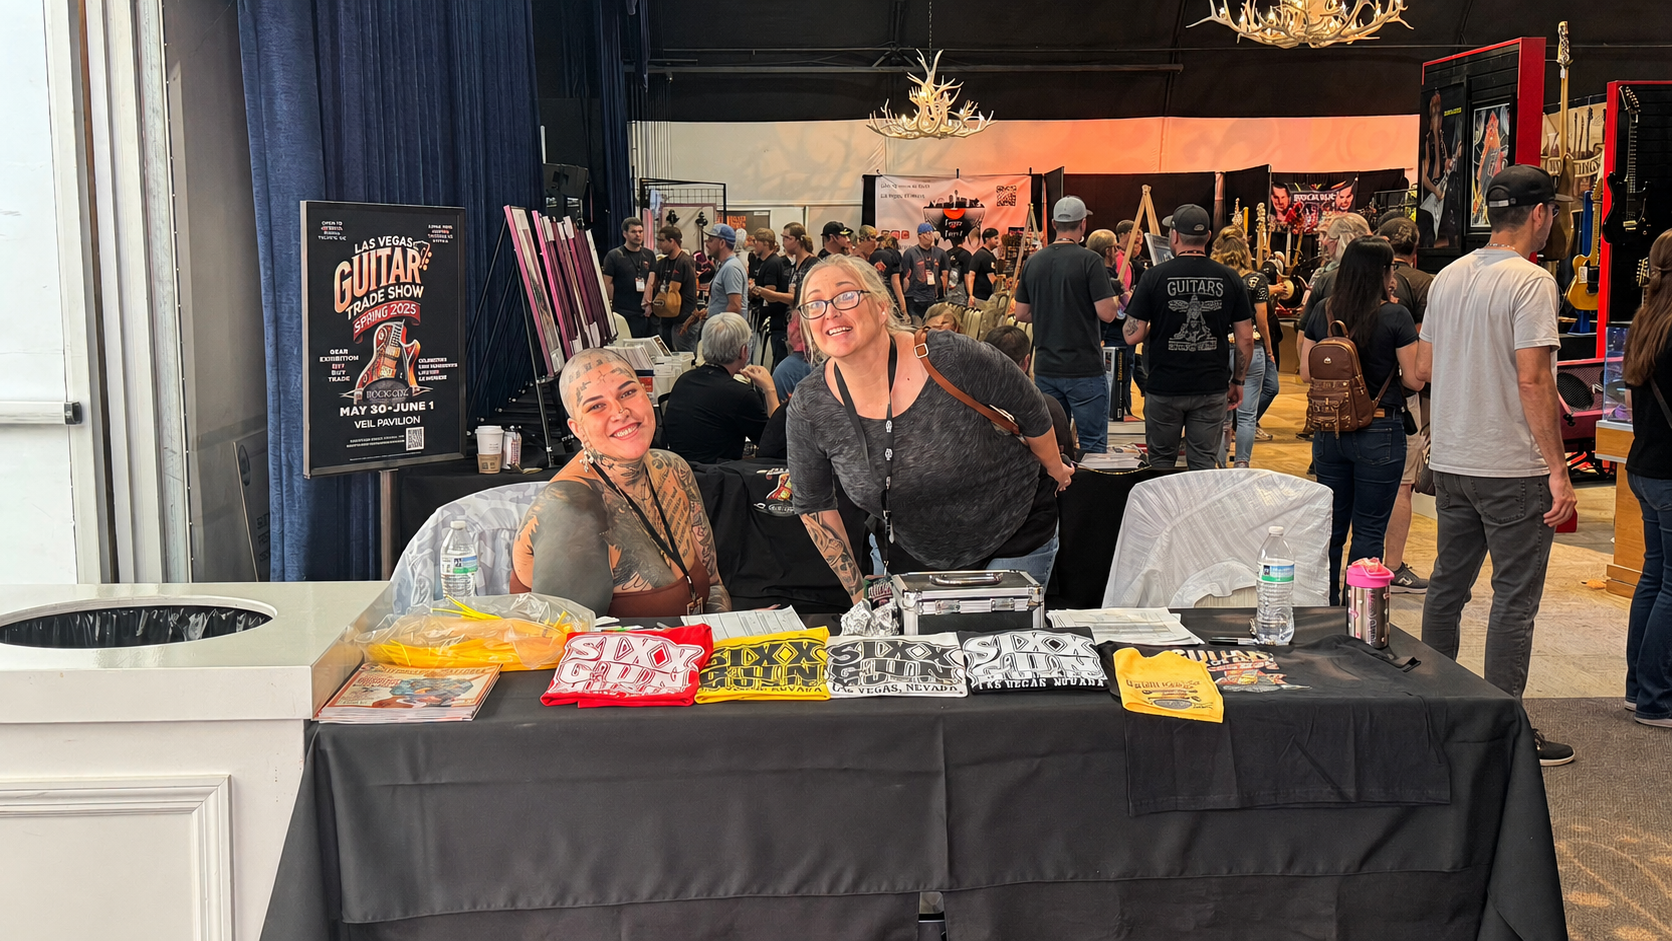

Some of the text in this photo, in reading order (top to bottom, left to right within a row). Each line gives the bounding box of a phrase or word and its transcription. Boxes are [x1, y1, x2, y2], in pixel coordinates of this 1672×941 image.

[354, 236, 413, 253] LAS VEGAS
[334, 247, 422, 314] GUITAR
[1167, 280, 1224, 297] GUITARS
[346, 285, 424, 320] TRADE SHOW
[354, 303, 417, 334] SPRING 2025
[339, 405, 368, 417] MAY
[429, 401, 434, 410] 1
[354, 415, 421, 429] VEIL PAVILION
